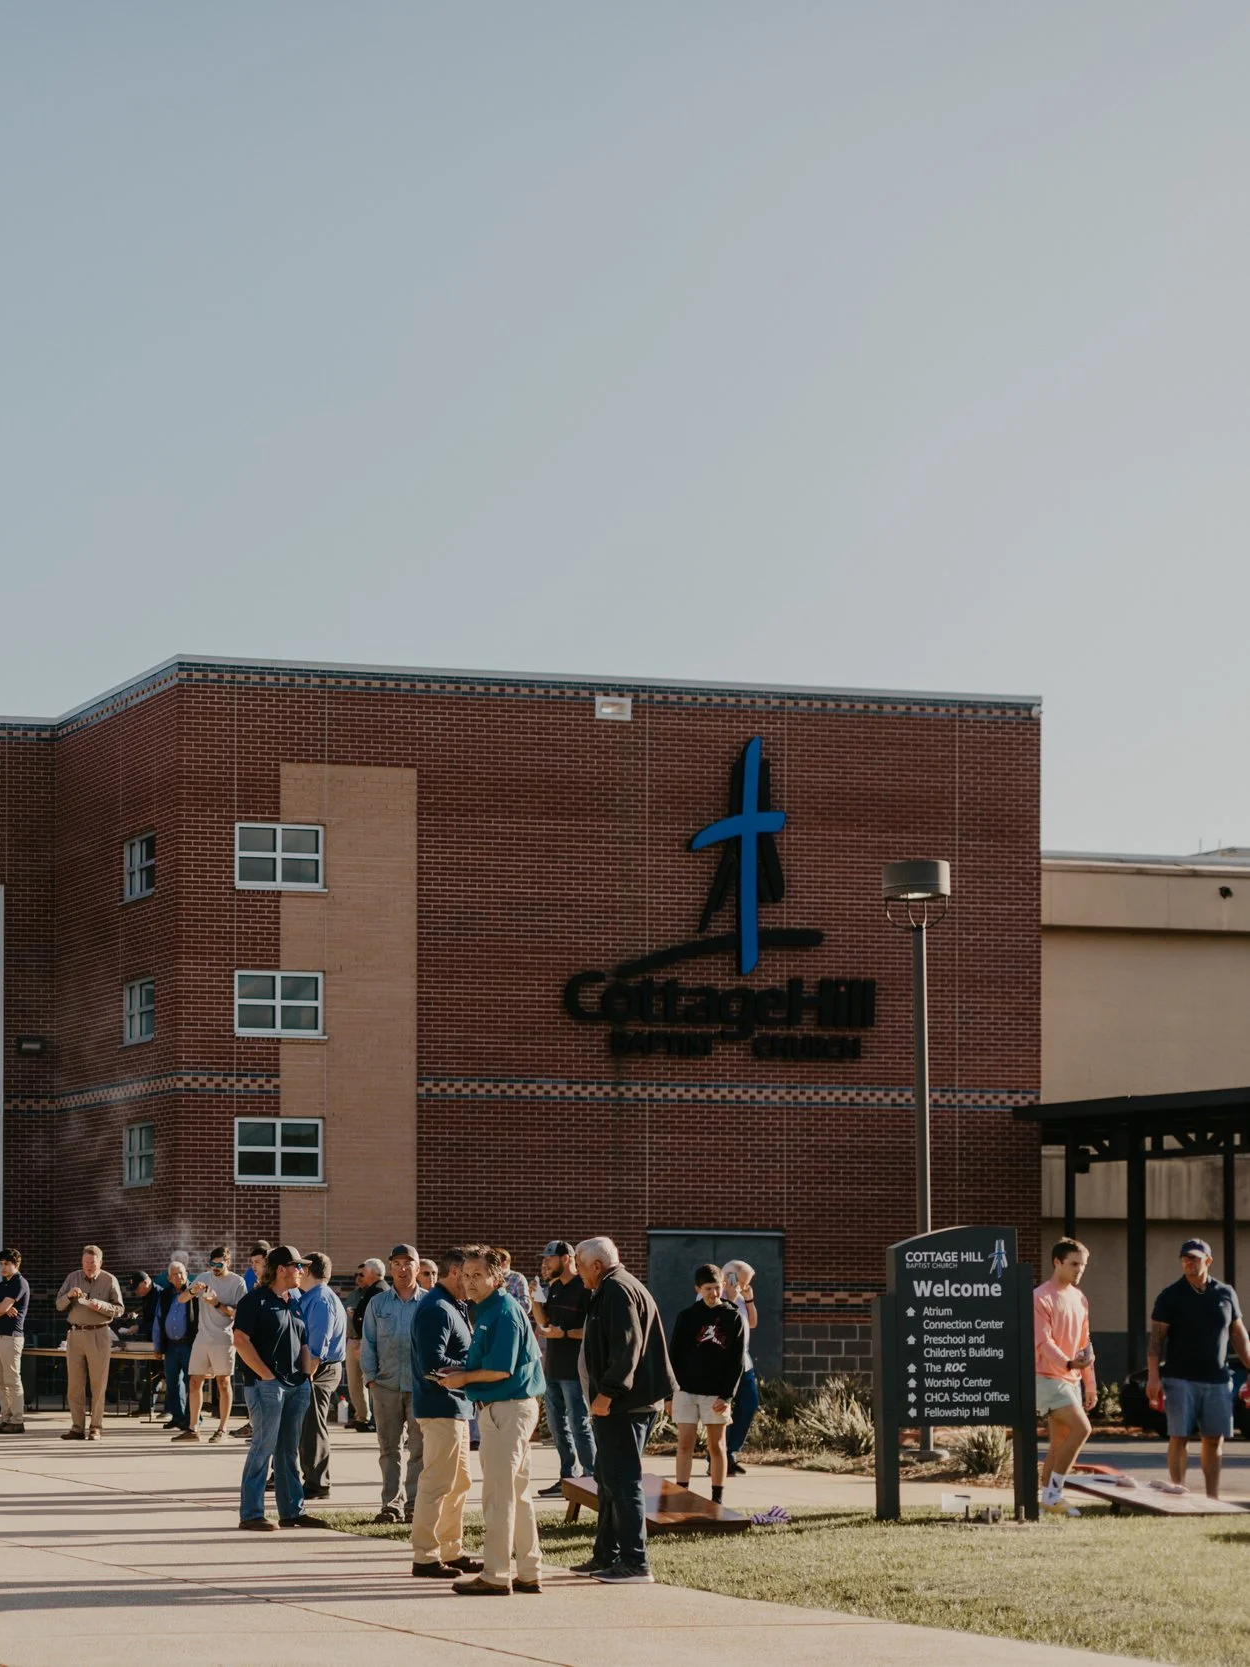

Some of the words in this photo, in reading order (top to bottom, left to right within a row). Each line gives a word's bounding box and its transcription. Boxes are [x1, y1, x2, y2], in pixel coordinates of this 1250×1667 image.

[905, 1251, 958, 1262] COTTAGE
[961, 1251, 984, 1262] HILL
[913, 1279, 1002, 1297] Welcome
[922, 1306, 953, 1316] Atrium
[923, 1319, 972, 1329] Connection
[974, 1319, 1004, 1329] Center
[923, 1334, 966, 1344] Preschool
[968, 1334, 985, 1344] and
[968, 1347, 1004, 1359] Building
[923, 1362, 942, 1372] The
[944, 1362, 967, 1372] ROC
[924, 1377, 960, 1389] Worship
[962, 1377, 992, 1387] Center
[924, 1392, 950, 1402] CHCA
[952, 1392, 982, 1402] School
[983, 1392, 1010, 1402] Office
[924, 1407, 970, 1419] Fellowship
[972, 1407, 990, 1417] Hall
